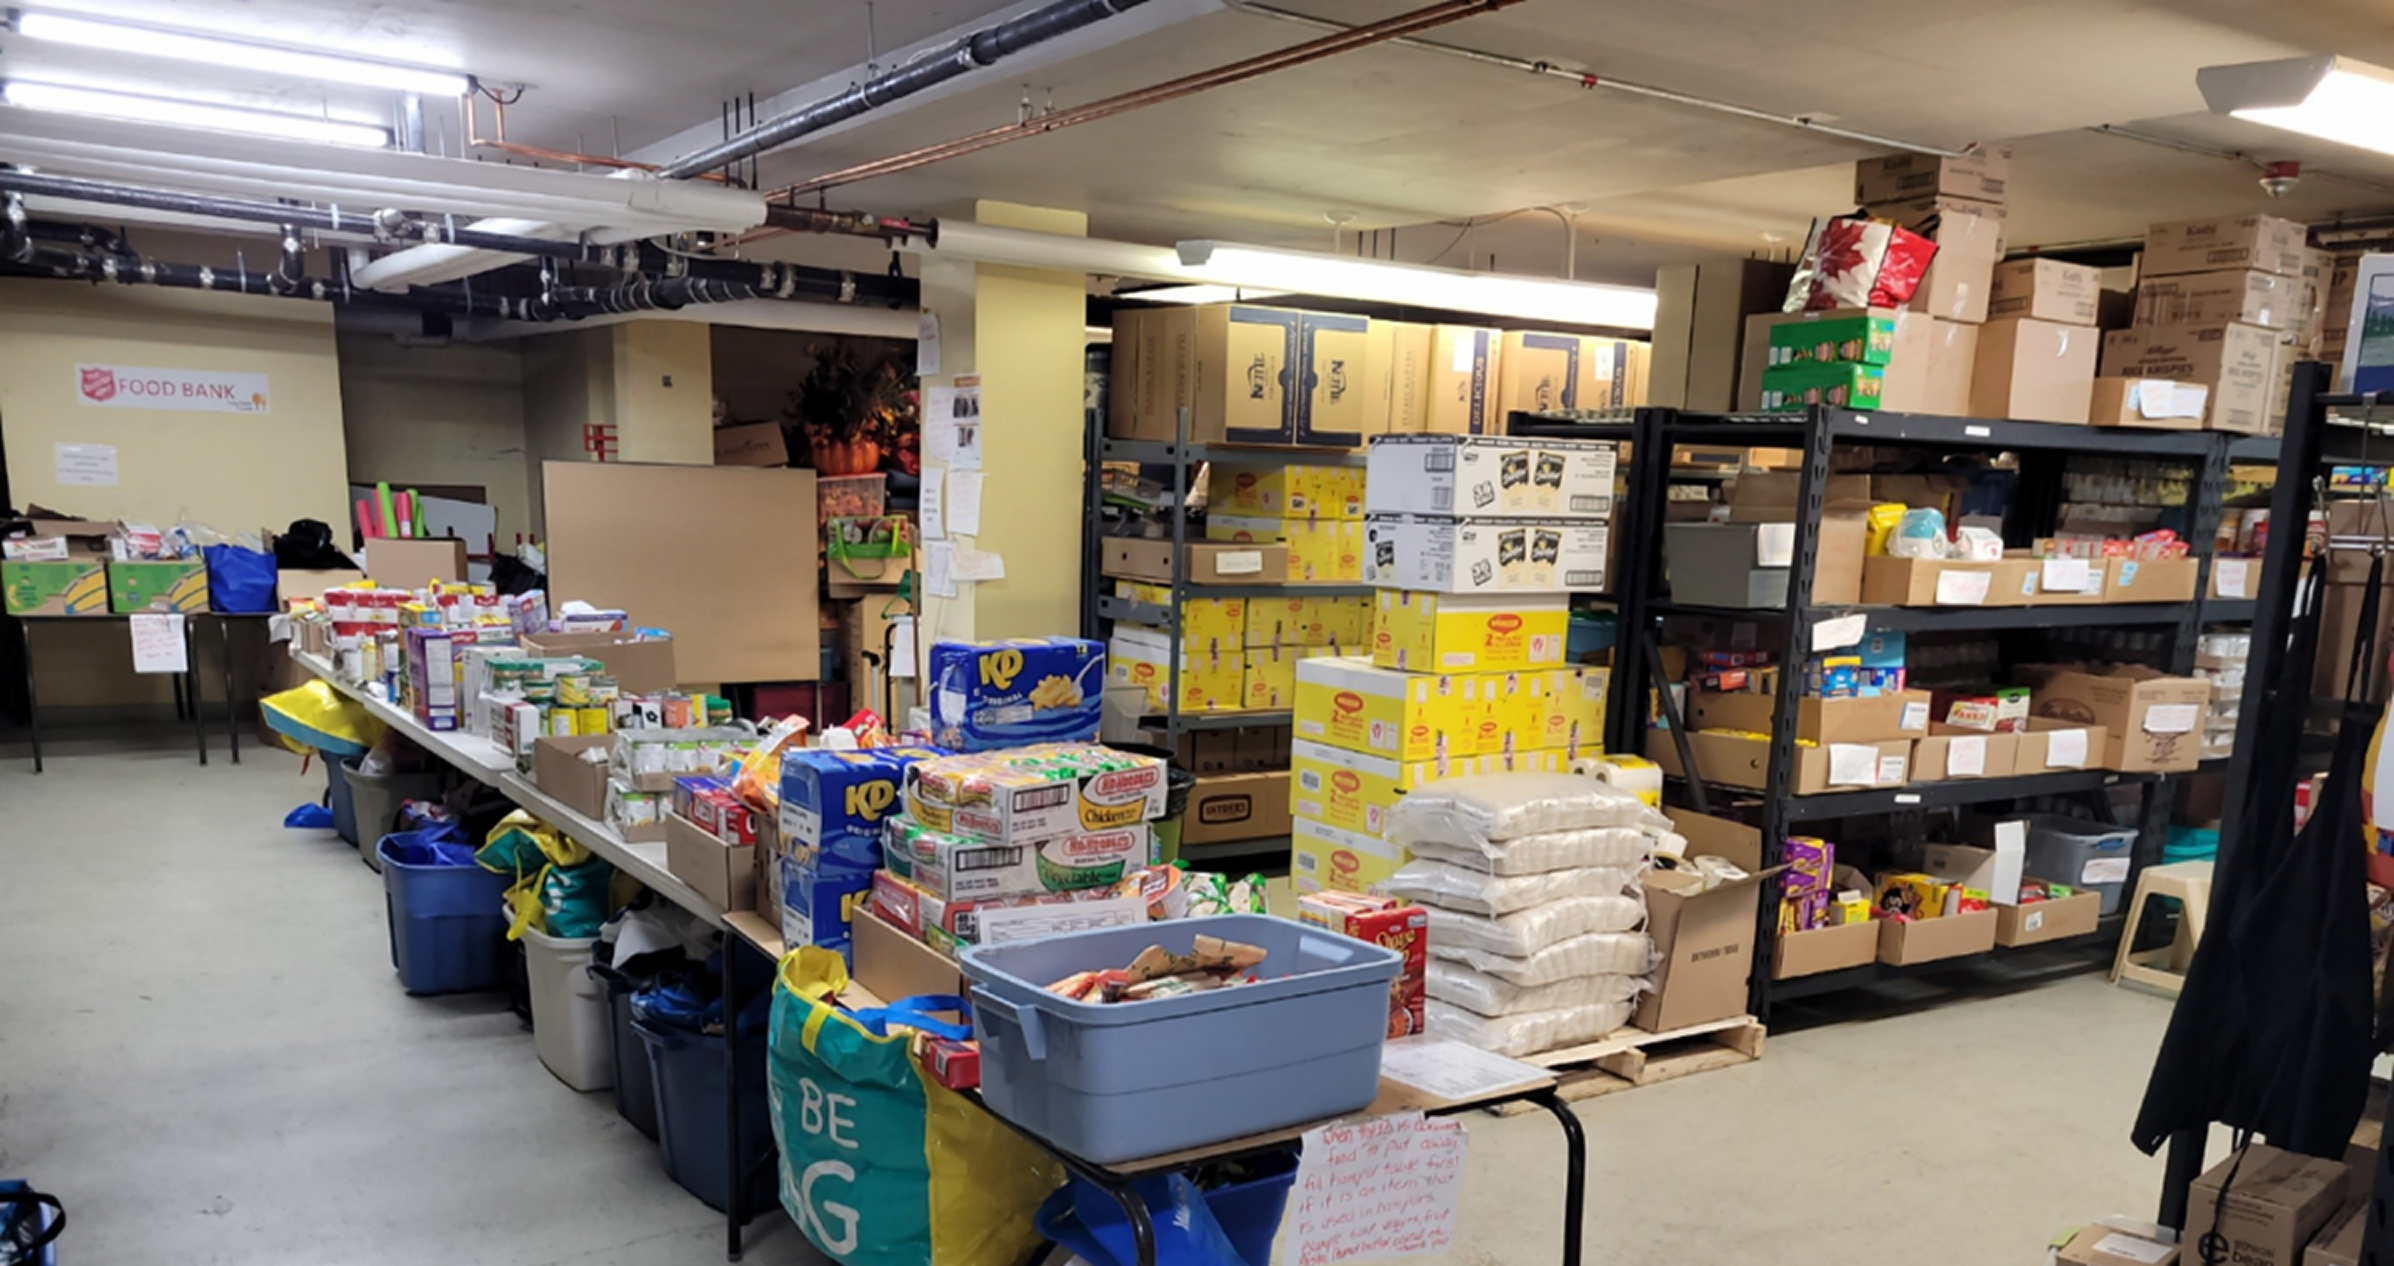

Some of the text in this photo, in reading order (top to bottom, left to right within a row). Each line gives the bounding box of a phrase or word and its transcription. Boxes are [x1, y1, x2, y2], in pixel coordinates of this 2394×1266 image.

[119, 378, 176, 397] FOOD
[181, 382, 236, 400] BANK
[979, 649, 1024, 690] KD
[845, 780, 895, 821] KD
[1085, 808, 1126, 824] Chicken
[799, 1077, 859, 1149] BE
[1384, 1137, 1410, 1158] put
[1381, 1175, 1418, 1193] item
[1359, 1205, 1374, 1218] in
